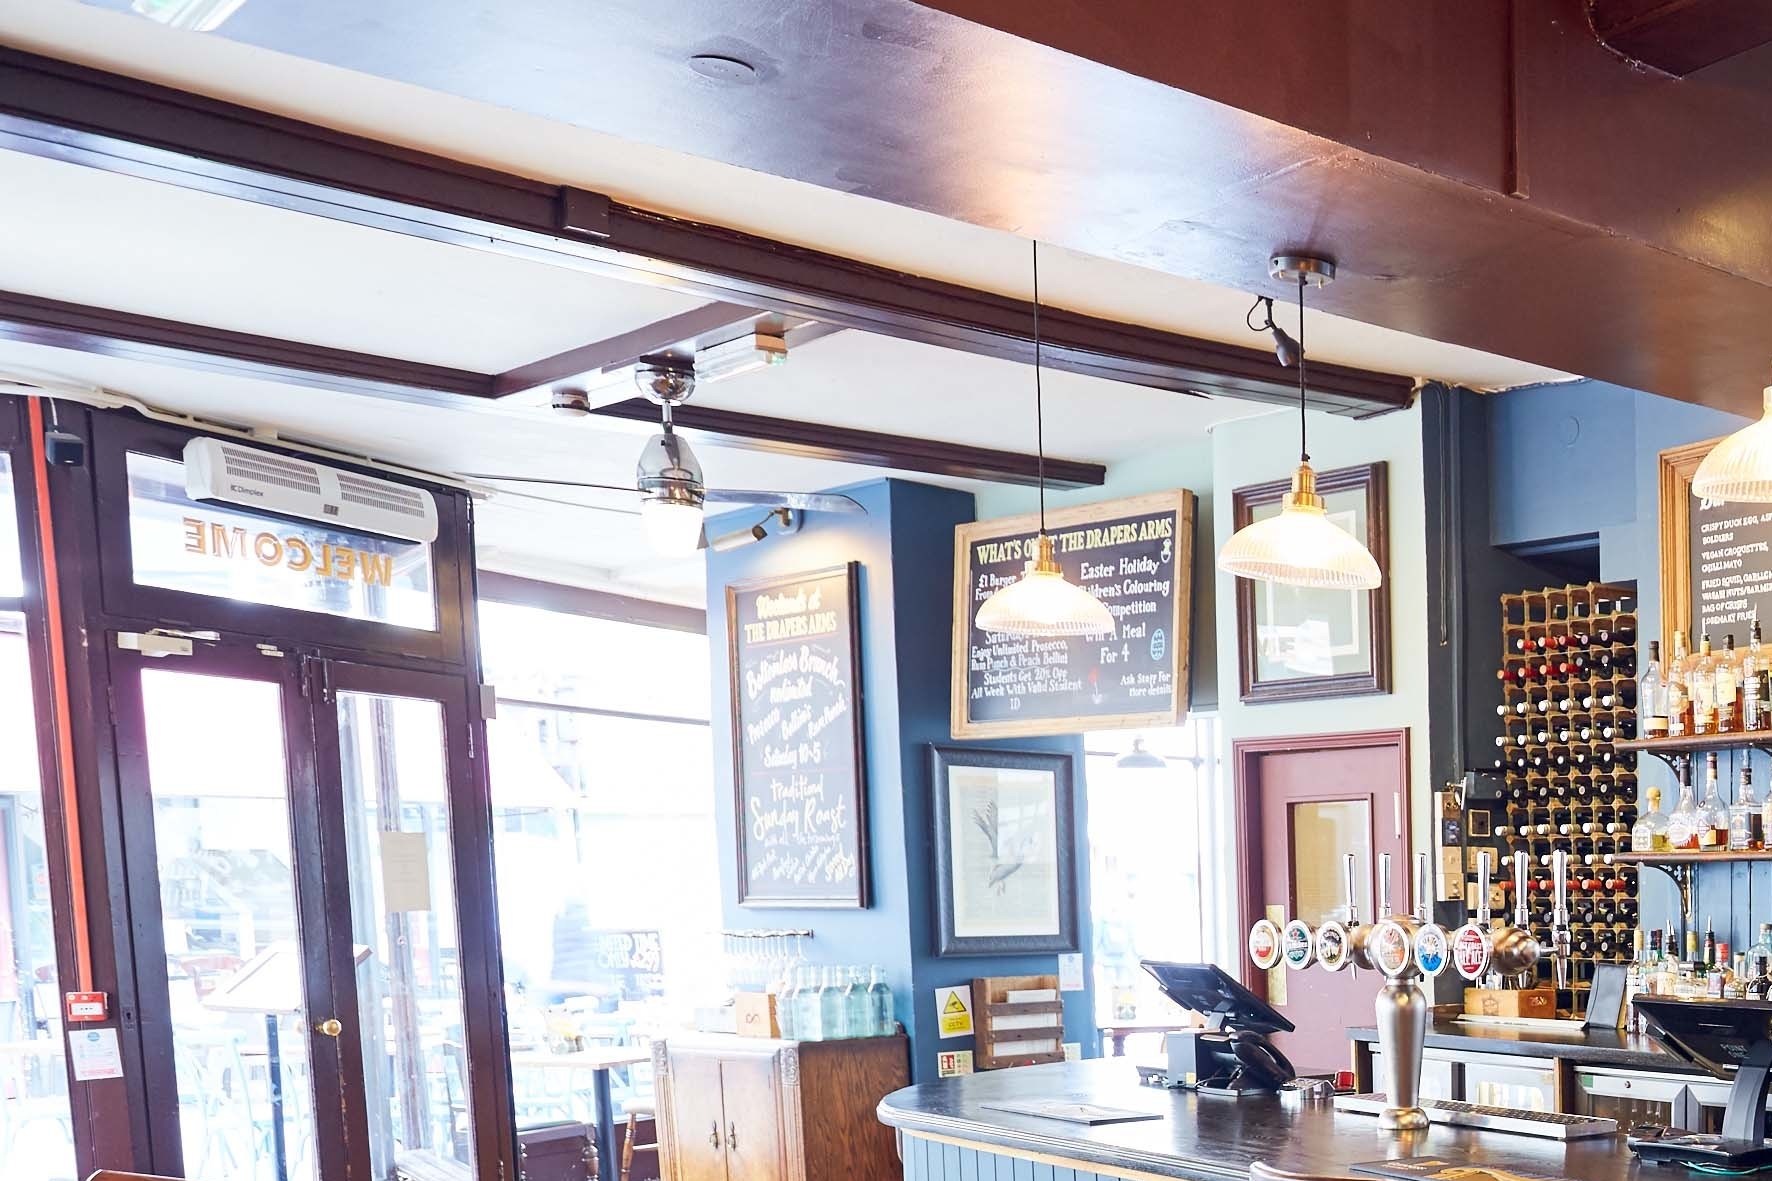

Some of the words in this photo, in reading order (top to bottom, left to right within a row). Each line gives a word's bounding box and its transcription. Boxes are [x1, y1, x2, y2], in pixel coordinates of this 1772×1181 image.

[238, 485, 264, 497] Dimplex
[1701, 522, 1723, 533] CRISPY
[1723, 518, 1743, 530] DUCK
[977, 539, 1021, 565] WHAT'S
[1060, 531, 1086, 552] THE
[1086, 523, 1139, 549] DRAPERS
[1139, 518, 1173, 543] ARMS
[1701, 548, 1724, 560] VEGAN
[1080, 562, 1115, 580] Easter
[1119, 557, 1160, 576] Holiday
[1123, 580, 1170, 597] Colouring
[1701, 578, 1722, 590] FRIED
[744, 622, 766, 643] THE
[766, 616, 808, 641] DRAPERS
[808, 611, 837, 635] ARMS
[1704, 613, 1736, 625] OSEMARY
[1122, 623, 1146, 639] Meal
[992, 641, 1029, 656] Unlimited
[1100, 648, 1118, 664] For
[1121, 643, 1130, 662] 4
[984, 671, 1018, 686] Students
[1018, 669, 1032, 683] Get
[971, 687, 983, 699] All
[984, 685, 1004, 698] Week
[751, 796, 799, 840] Sunday
[805, 794, 846, 833] Roast
